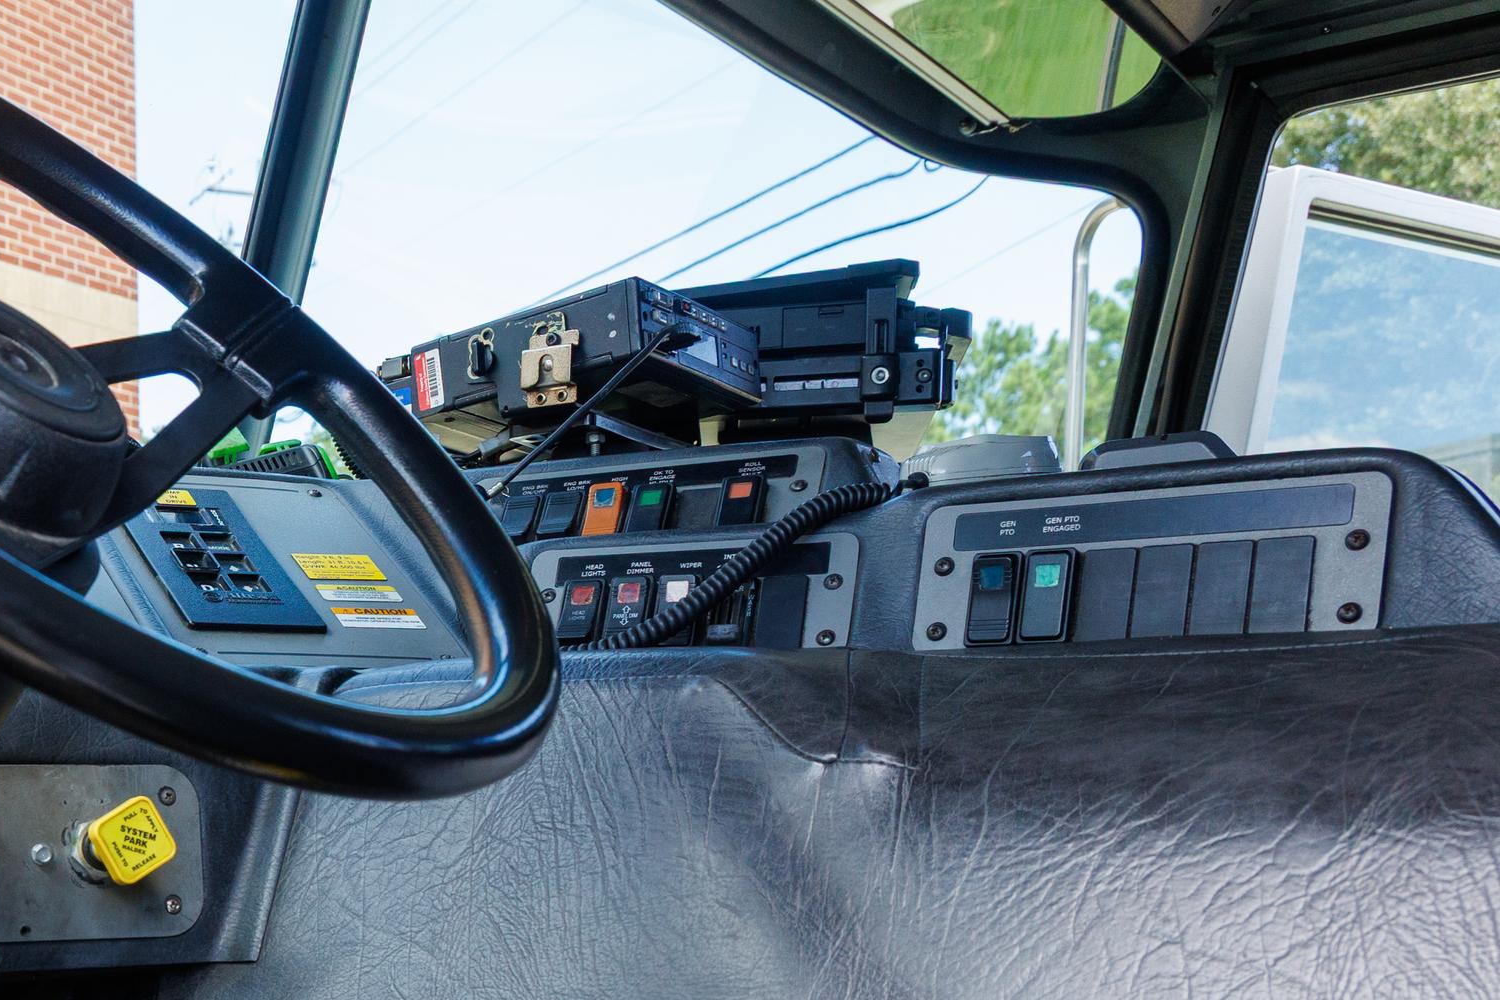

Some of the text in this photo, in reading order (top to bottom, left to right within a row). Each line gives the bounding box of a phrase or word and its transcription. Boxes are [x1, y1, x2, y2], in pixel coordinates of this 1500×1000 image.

[1000, 520, 1017, 528] GEN
[1045, 515, 1080, 525] GEN PTO
[999, 528, 1015, 536] PTO
[1042, 523, 1081, 533] ENGAGED
[626, 567, 655, 575] DIMMER
[123, 807, 159, 833] PULL TO APPLY
[119, 824, 157, 841] SYSTEM
[123, 835, 148, 848] PARK
[121, 844, 146, 855] HALDEX
[112, 841, 157, 872] PUSH TO RELEASE
